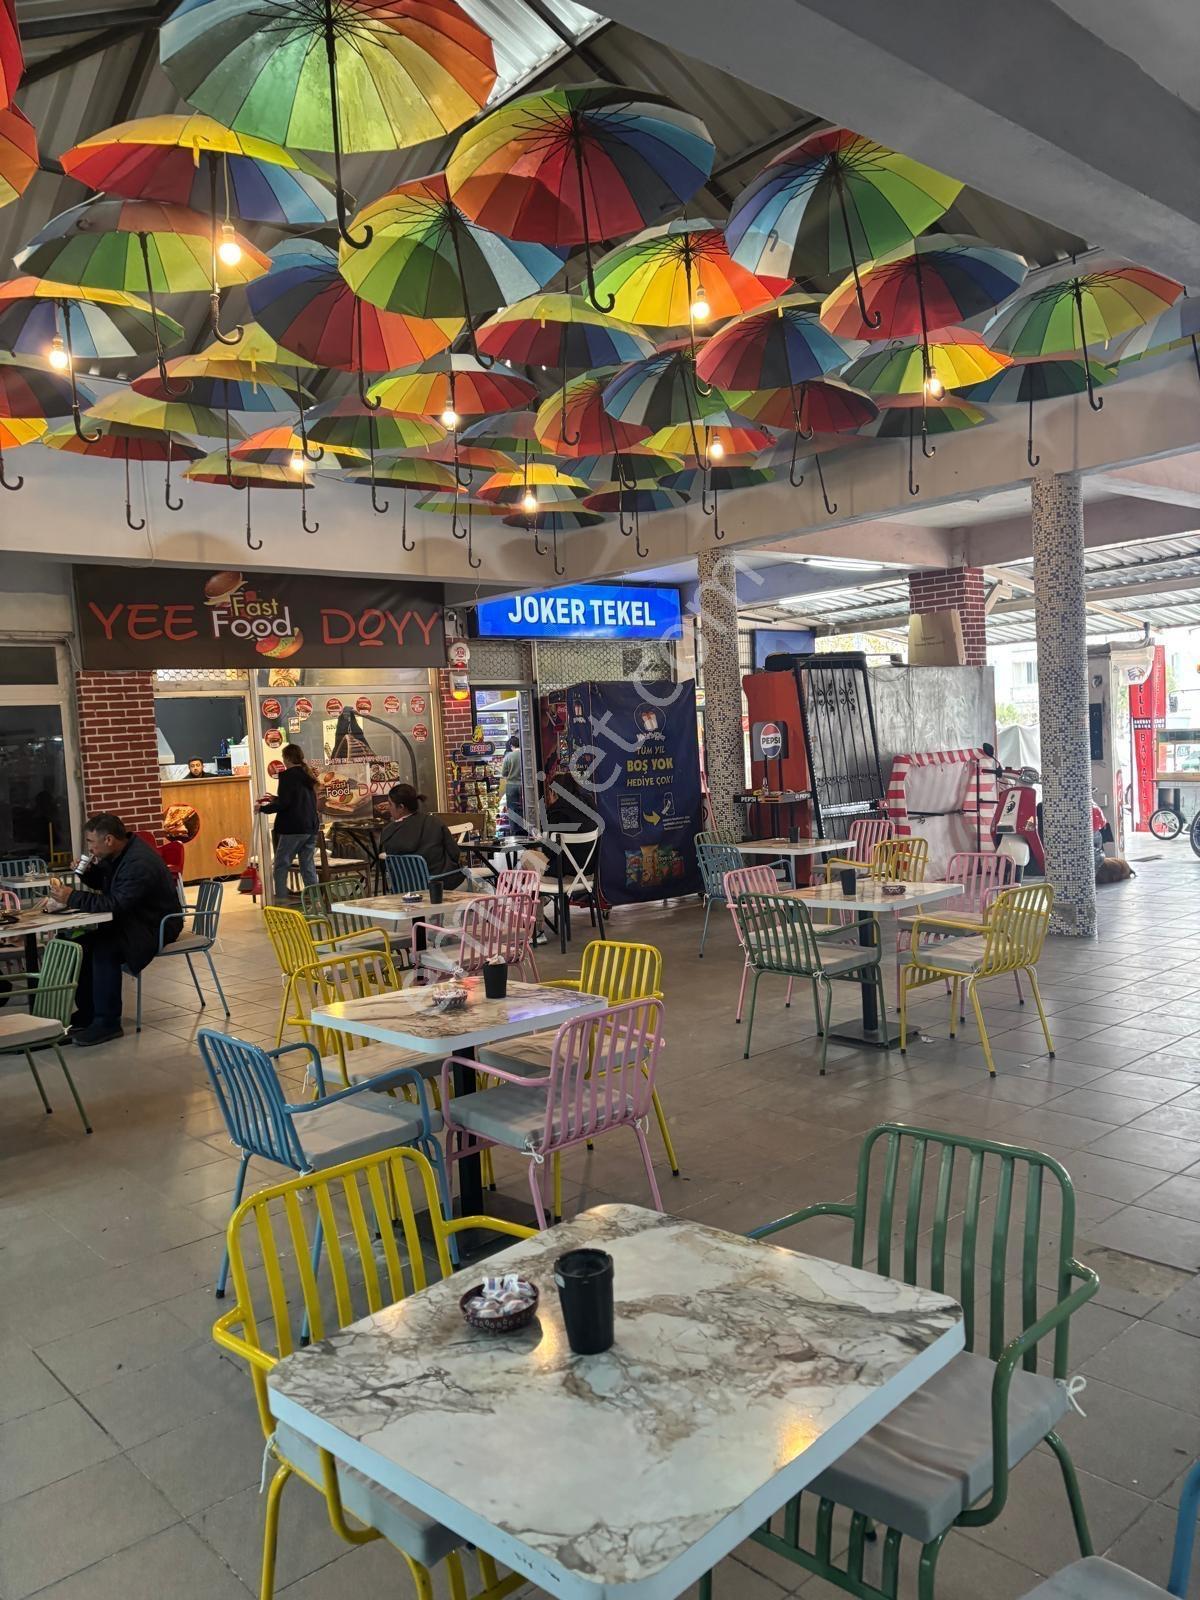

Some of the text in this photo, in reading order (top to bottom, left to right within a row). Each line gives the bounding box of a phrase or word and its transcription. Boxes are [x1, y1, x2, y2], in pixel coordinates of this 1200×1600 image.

[230, 595, 279, 616] Fast
[508, 596, 657, 627] JOKER TEKEL
[89, 602, 199, 641] YEE
[211, 606, 293, 639] Food
[761, 737, 781, 745] PEPSI
[627, 757, 674, 775] BOŞ YOK
[627, 775, 655, 787] HEDİYE
[326, 784, 351, 798] Food
